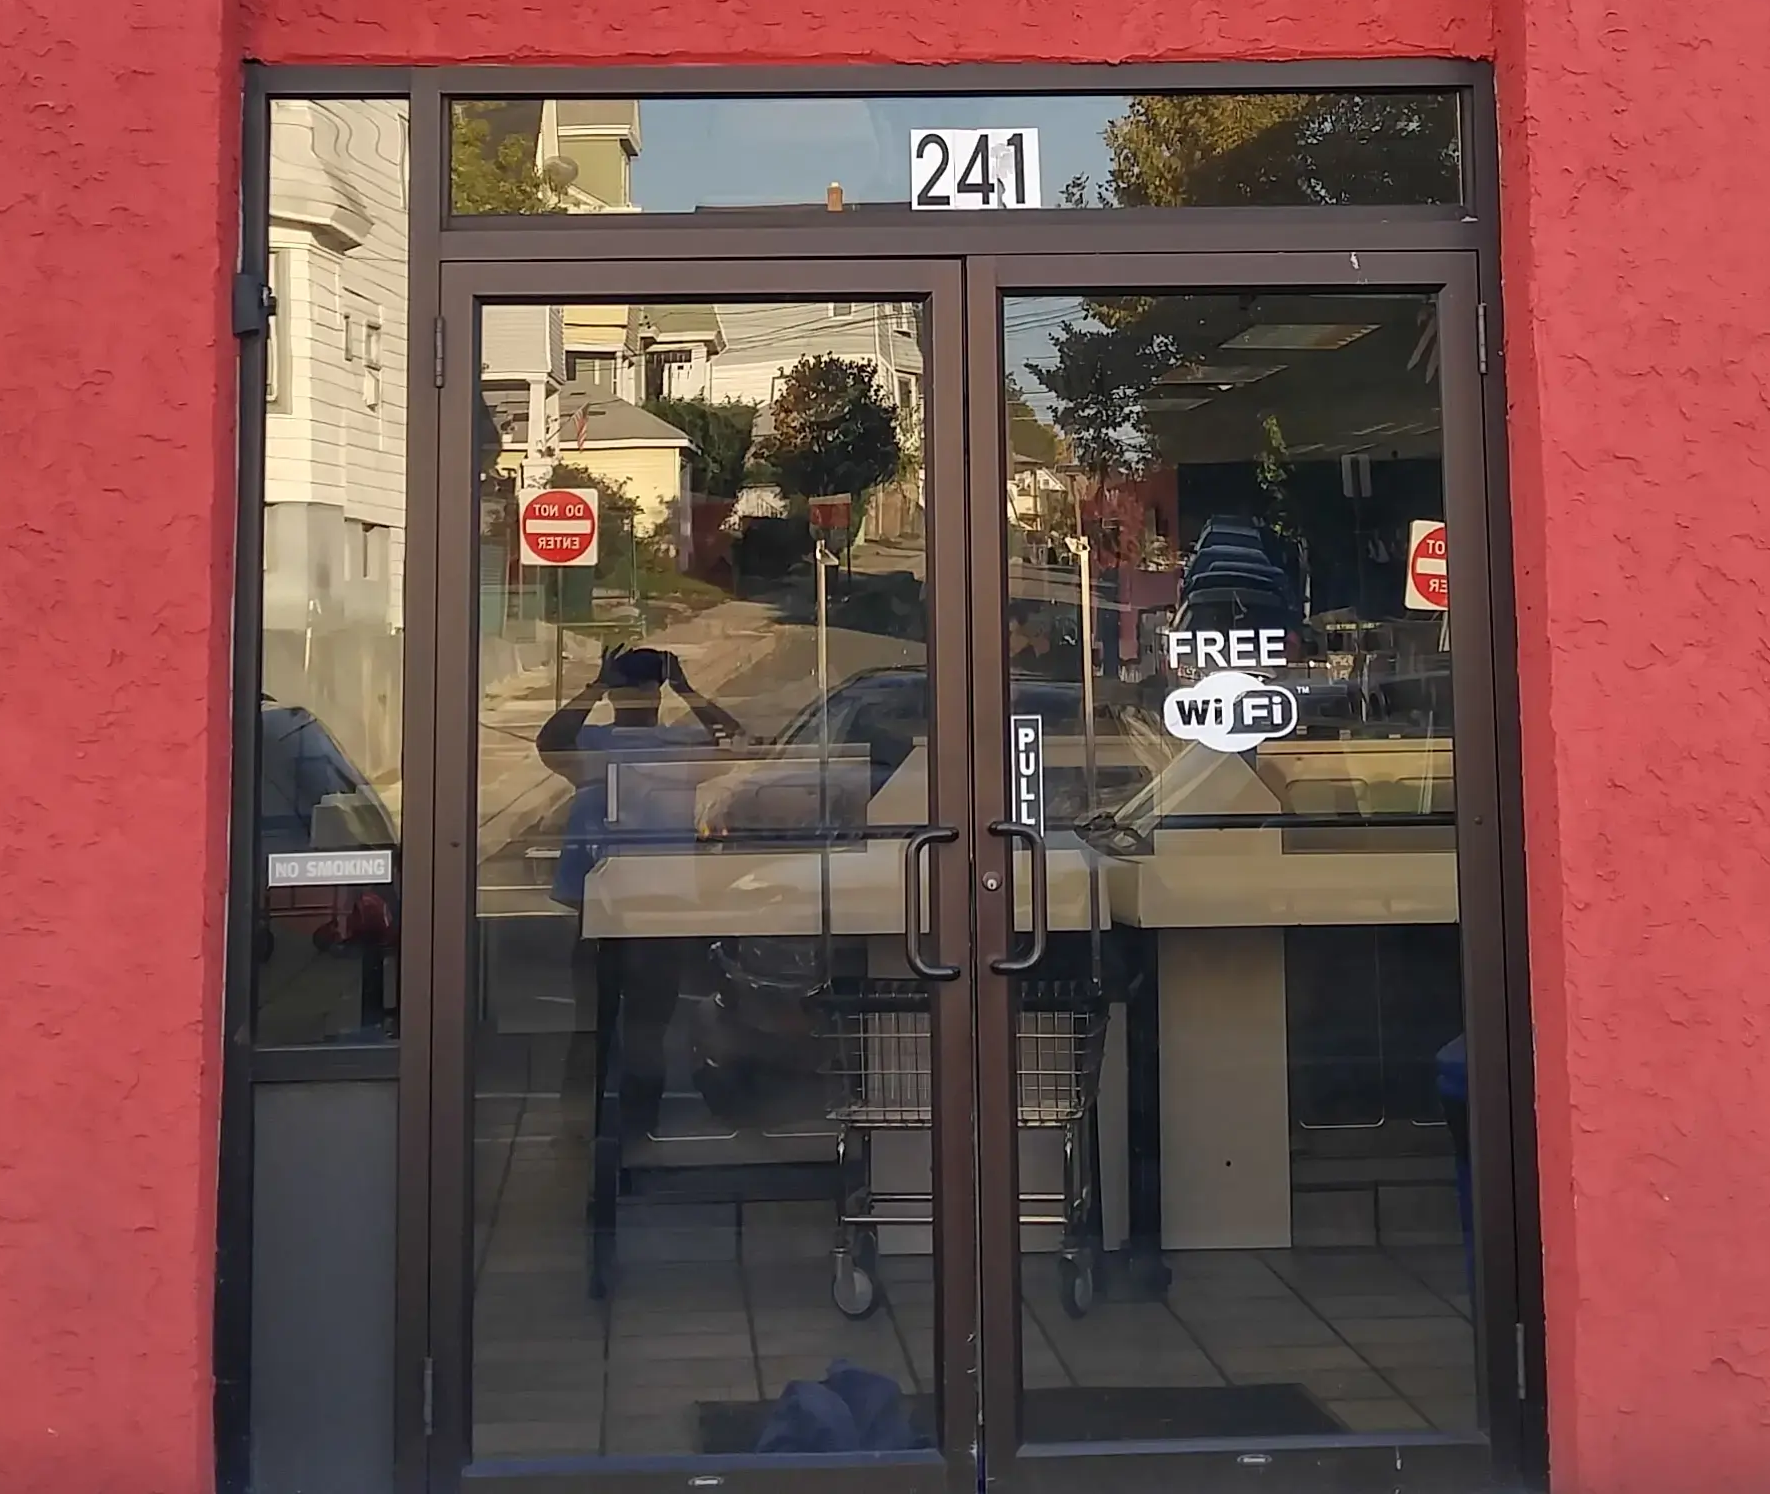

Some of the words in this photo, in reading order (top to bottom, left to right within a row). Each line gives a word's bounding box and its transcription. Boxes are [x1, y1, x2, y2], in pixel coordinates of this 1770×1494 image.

[916, 133, 1026, 206] 241
[1168, 629, 1287, 669] FREE
[1017, 727, 1036, 825] PULL
[275, 861, 299, 878] NO
[306, 858, 386, 878] SMOKING
